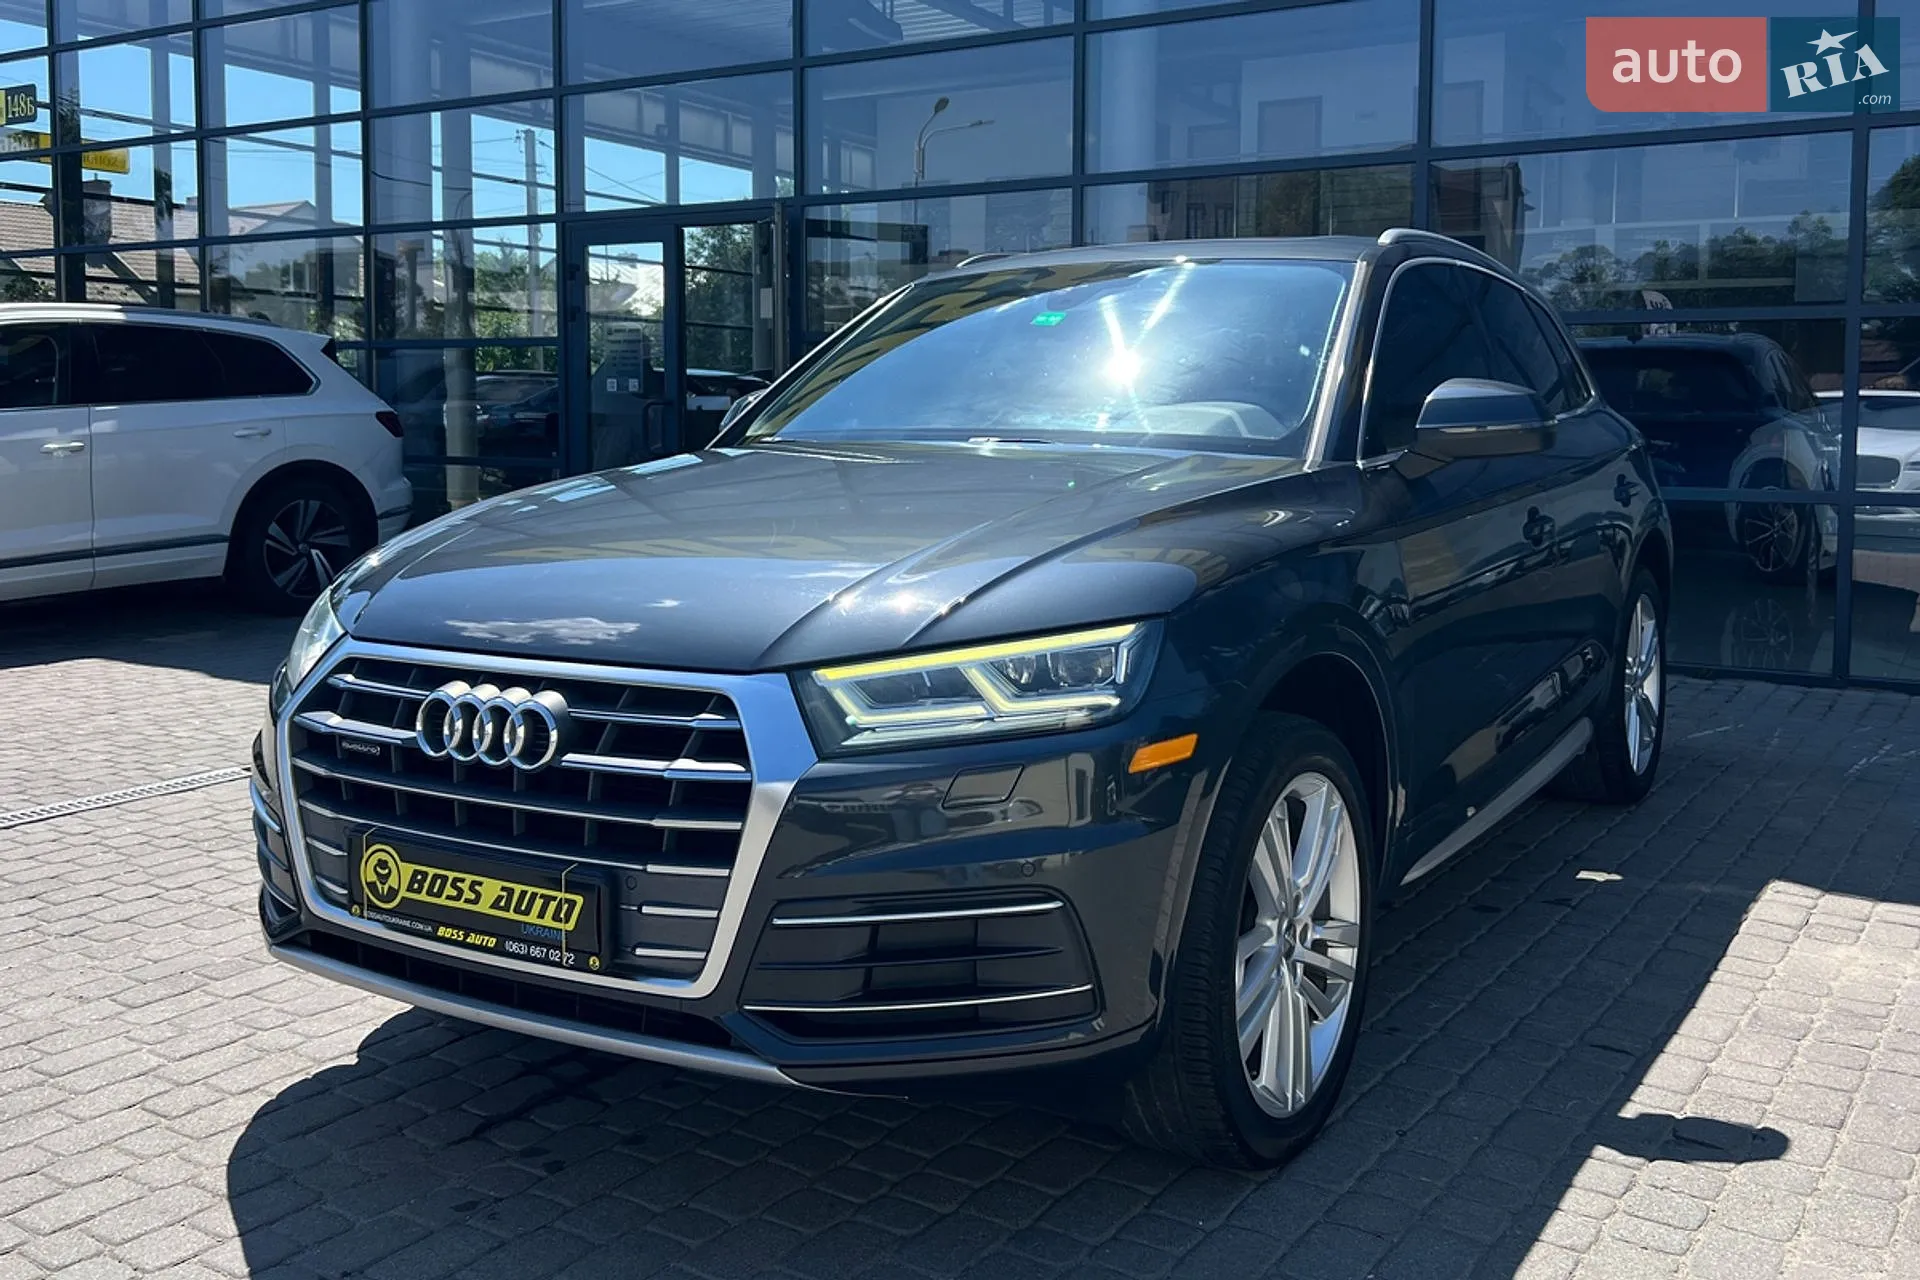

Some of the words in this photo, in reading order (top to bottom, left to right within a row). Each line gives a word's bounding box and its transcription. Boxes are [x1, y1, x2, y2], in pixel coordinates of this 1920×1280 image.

[406, 868, 484, 906] BOSS
[488, 886, 578, 925] AUTO
[436, 926, 465, 942] BOSS
[466, 932, 497, 949] AUTO
[504, 940, 528, 956] (063)
[529, 945, 546, 959] 667
[549, 950, 561, 963] 02
